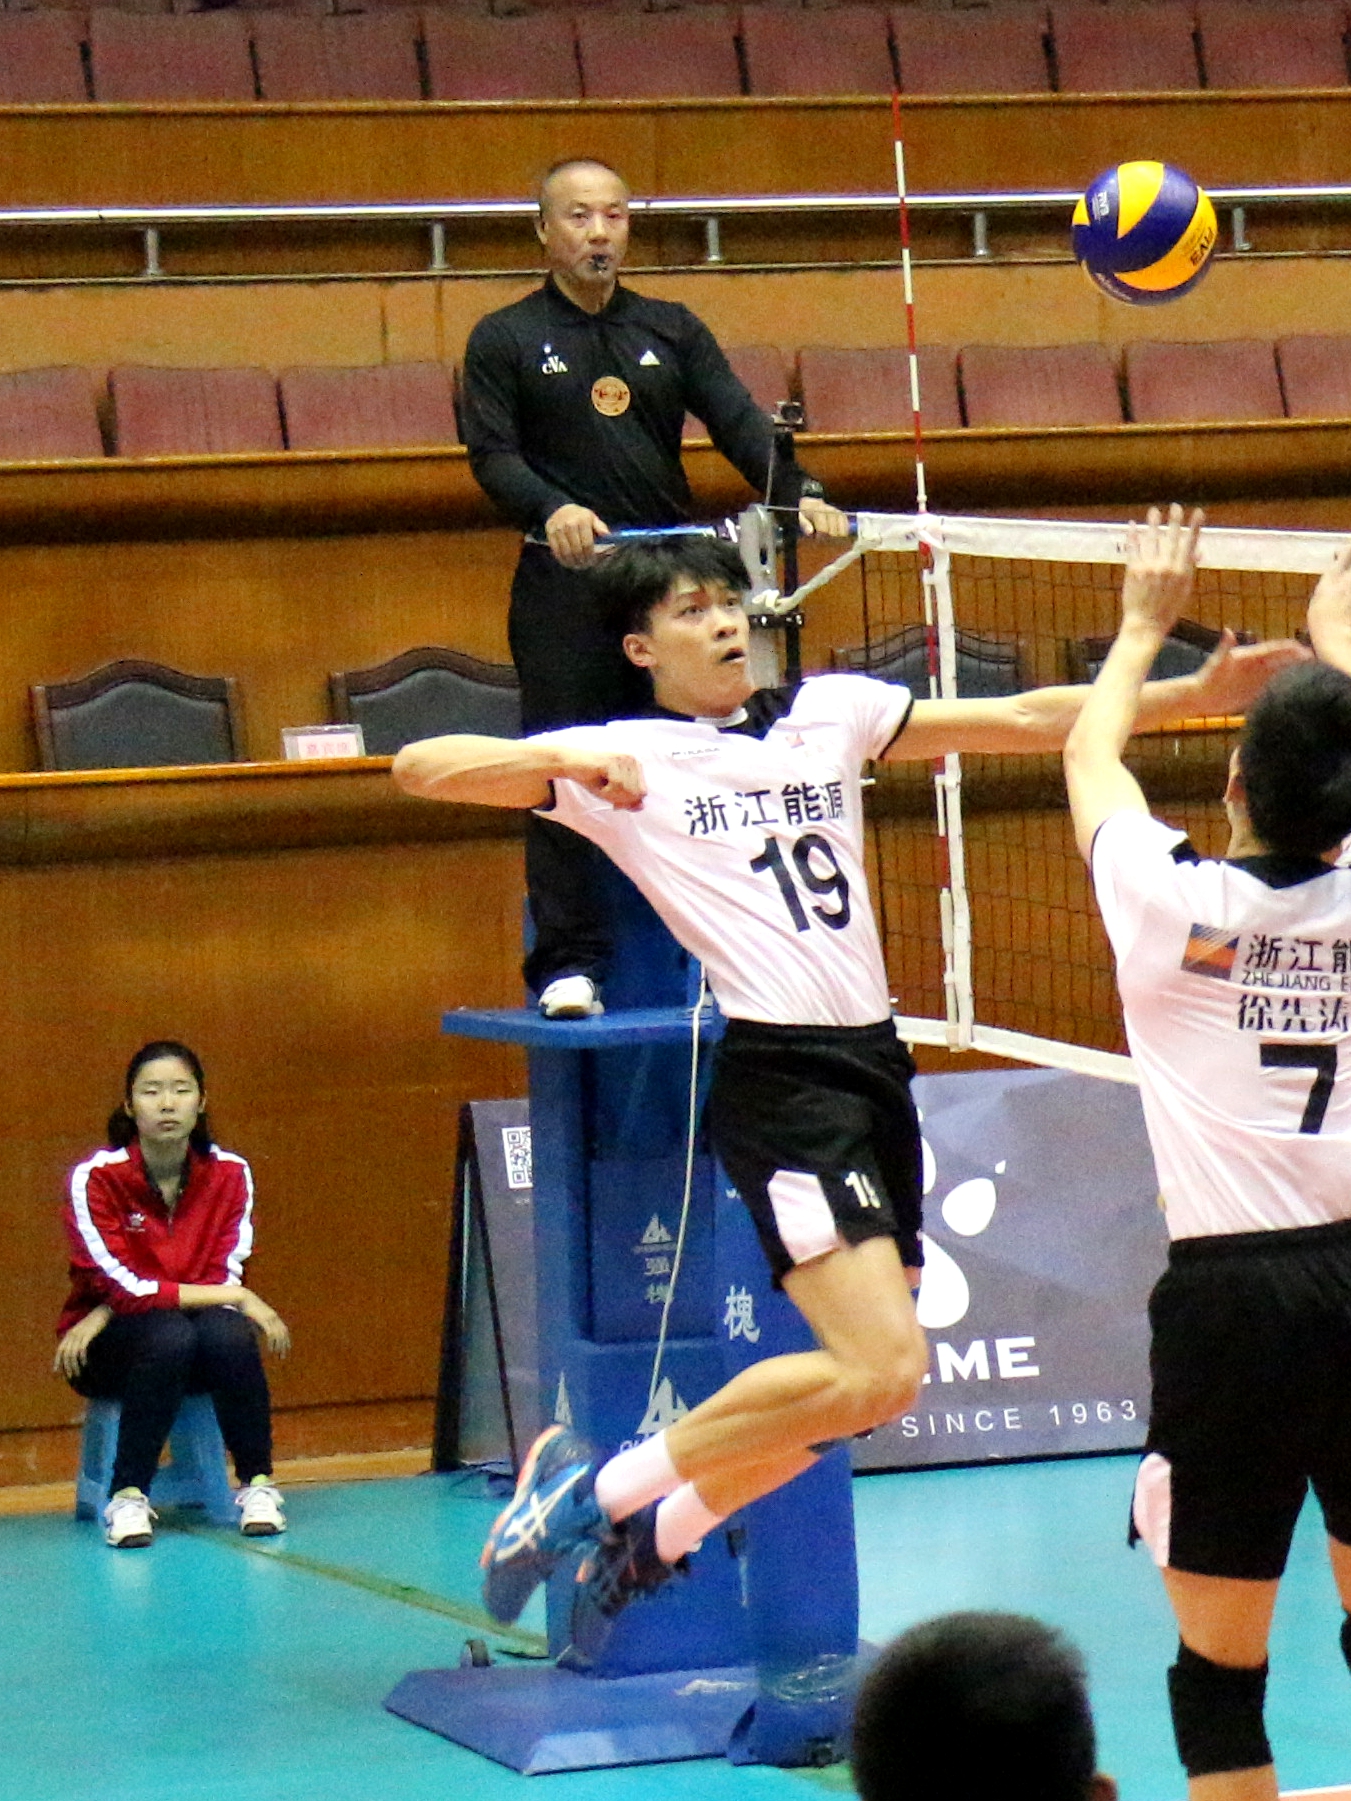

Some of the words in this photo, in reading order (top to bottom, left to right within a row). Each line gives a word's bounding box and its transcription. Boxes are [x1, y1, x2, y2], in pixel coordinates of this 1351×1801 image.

[684, 781, 843, 837] 浙江能源
[750, 834, 851, 933] 19
[1259, 1043, 1338, 1135] 7
[901, 1407, 1023, 1438] SINCE
[1049, 1399, 1137, 1427] 1963
